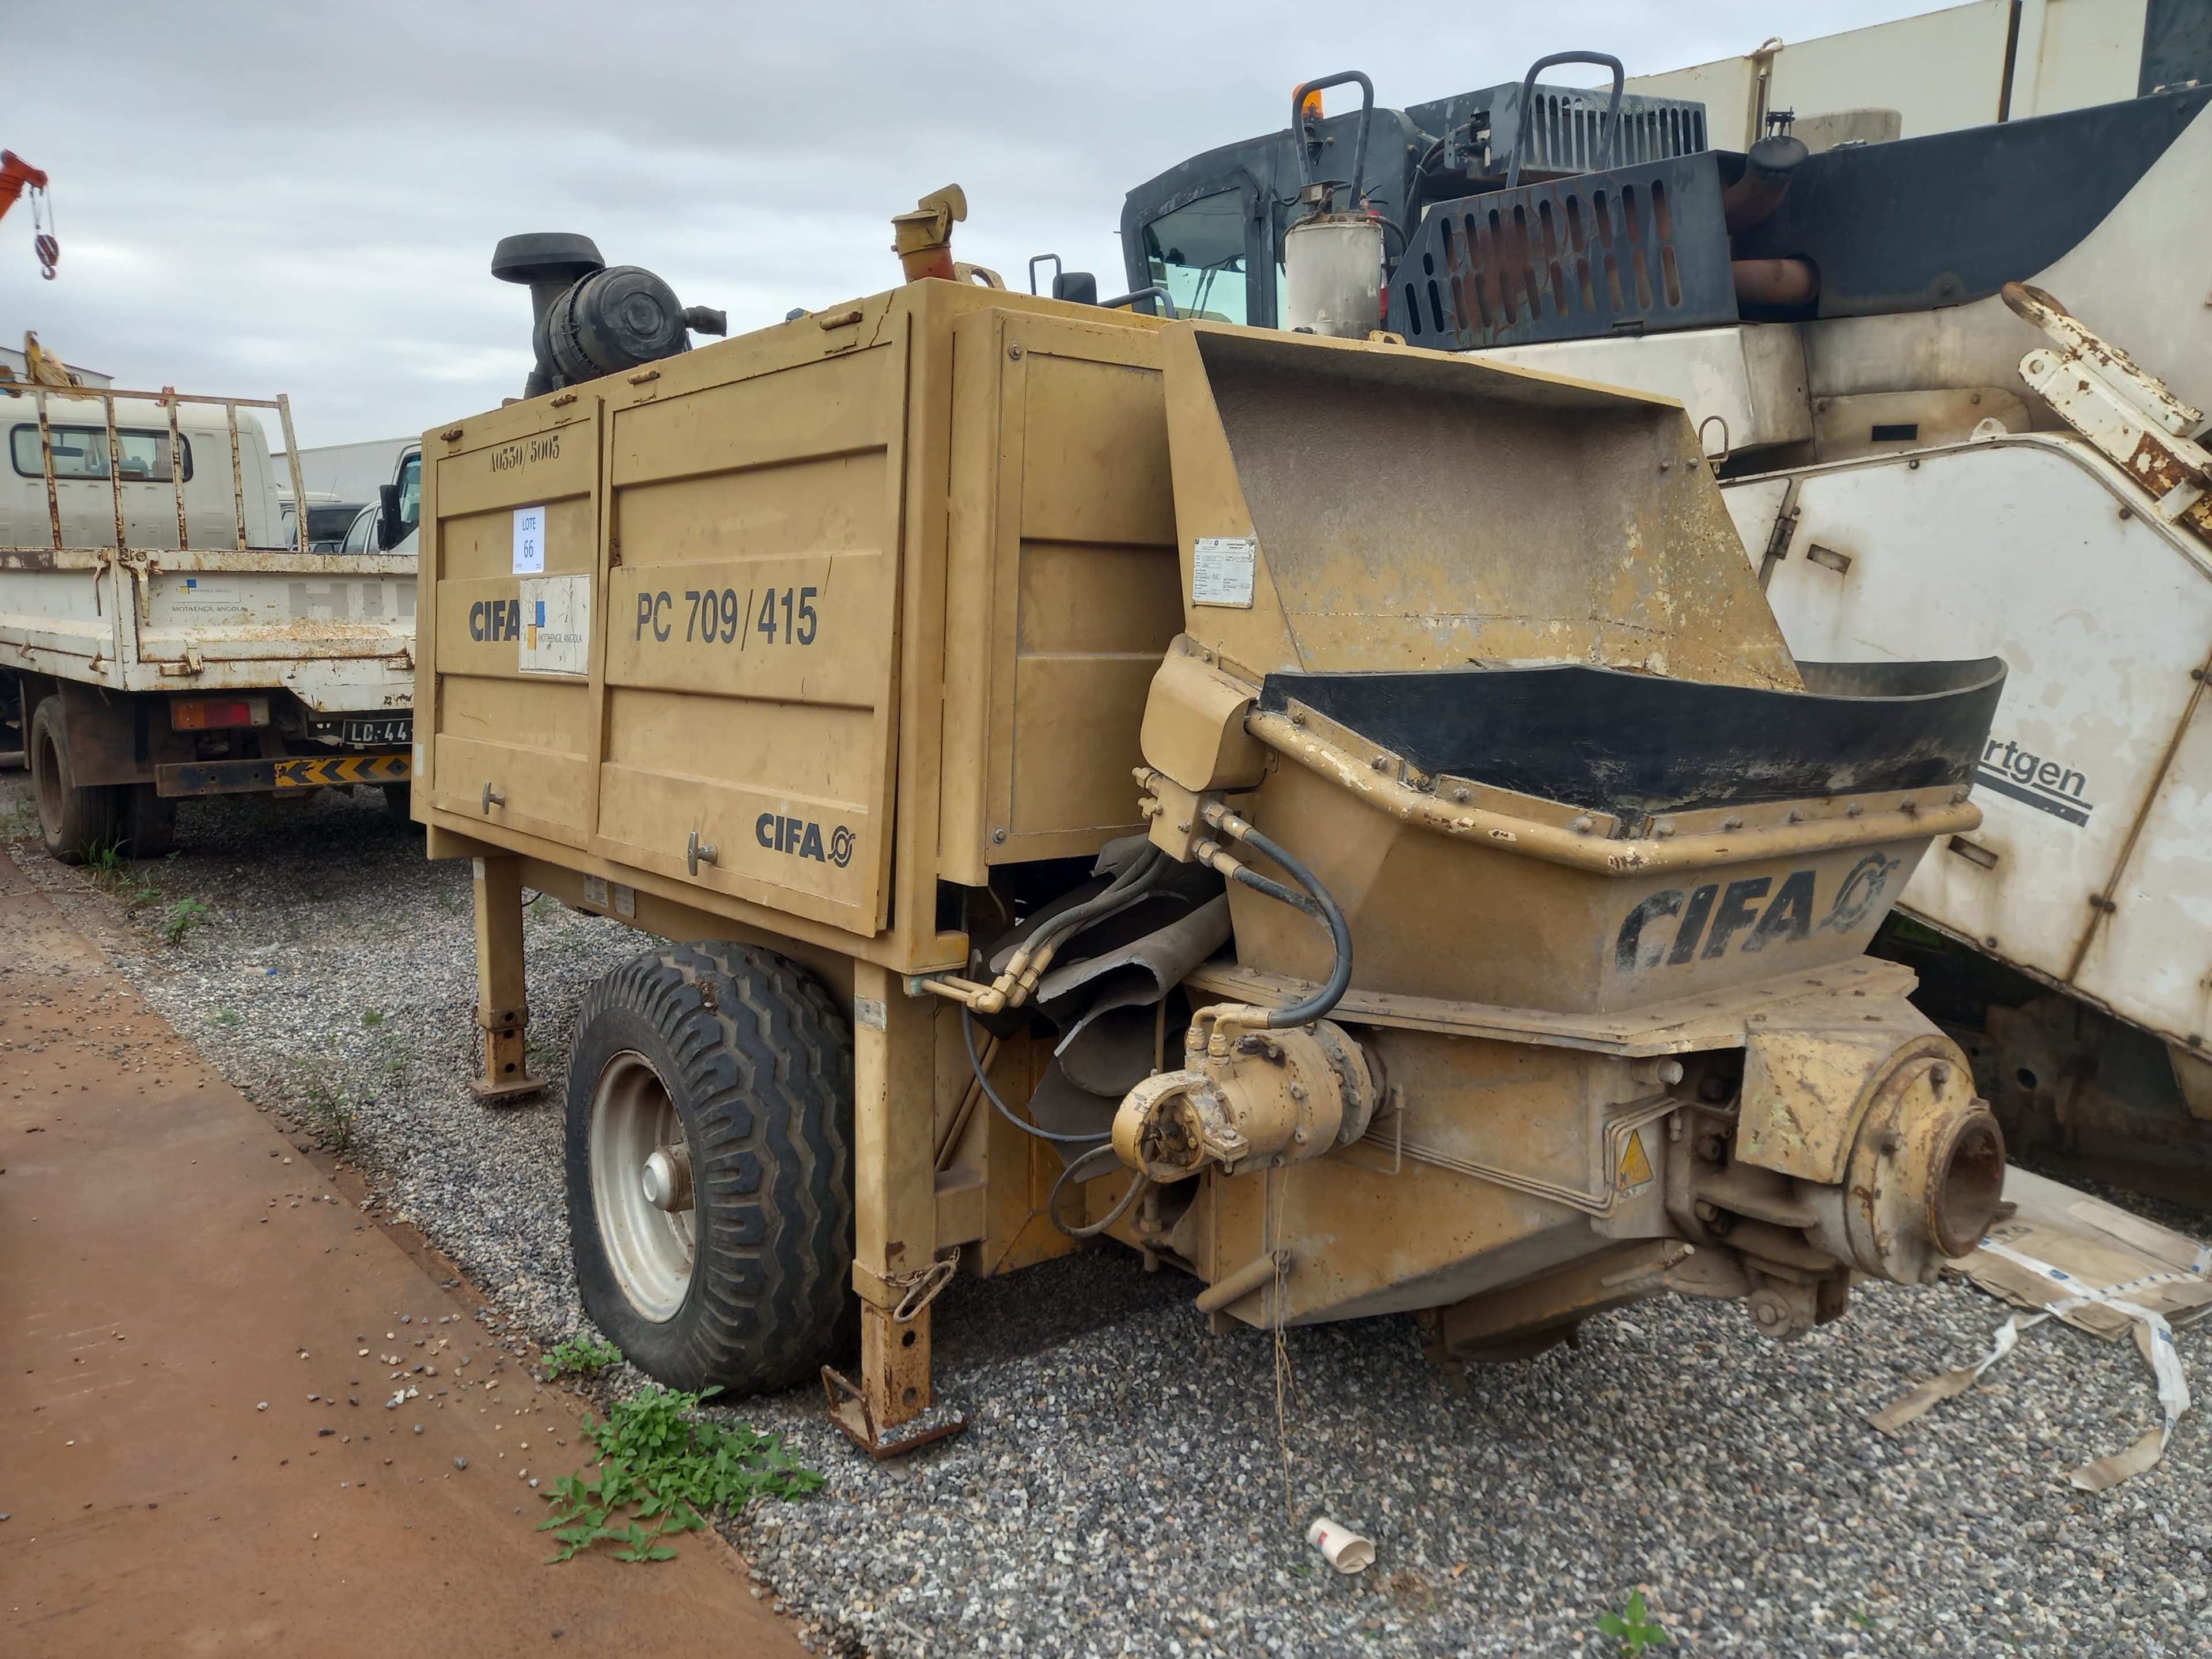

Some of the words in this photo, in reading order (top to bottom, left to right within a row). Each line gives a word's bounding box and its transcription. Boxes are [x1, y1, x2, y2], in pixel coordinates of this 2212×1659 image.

[522, 517, 536, 531] LOTE
[524, 540, 534, 558] 66
[469, 600, 520, 642] CIFA
[636, 591, 672, 642] PC
[685, 587, 817, 652] 709/415
[1983, 740, 2086, 797] rtgen
[756, 813, 826, 863] CIFA
[1615, 870, 1816, 974] CIFA
